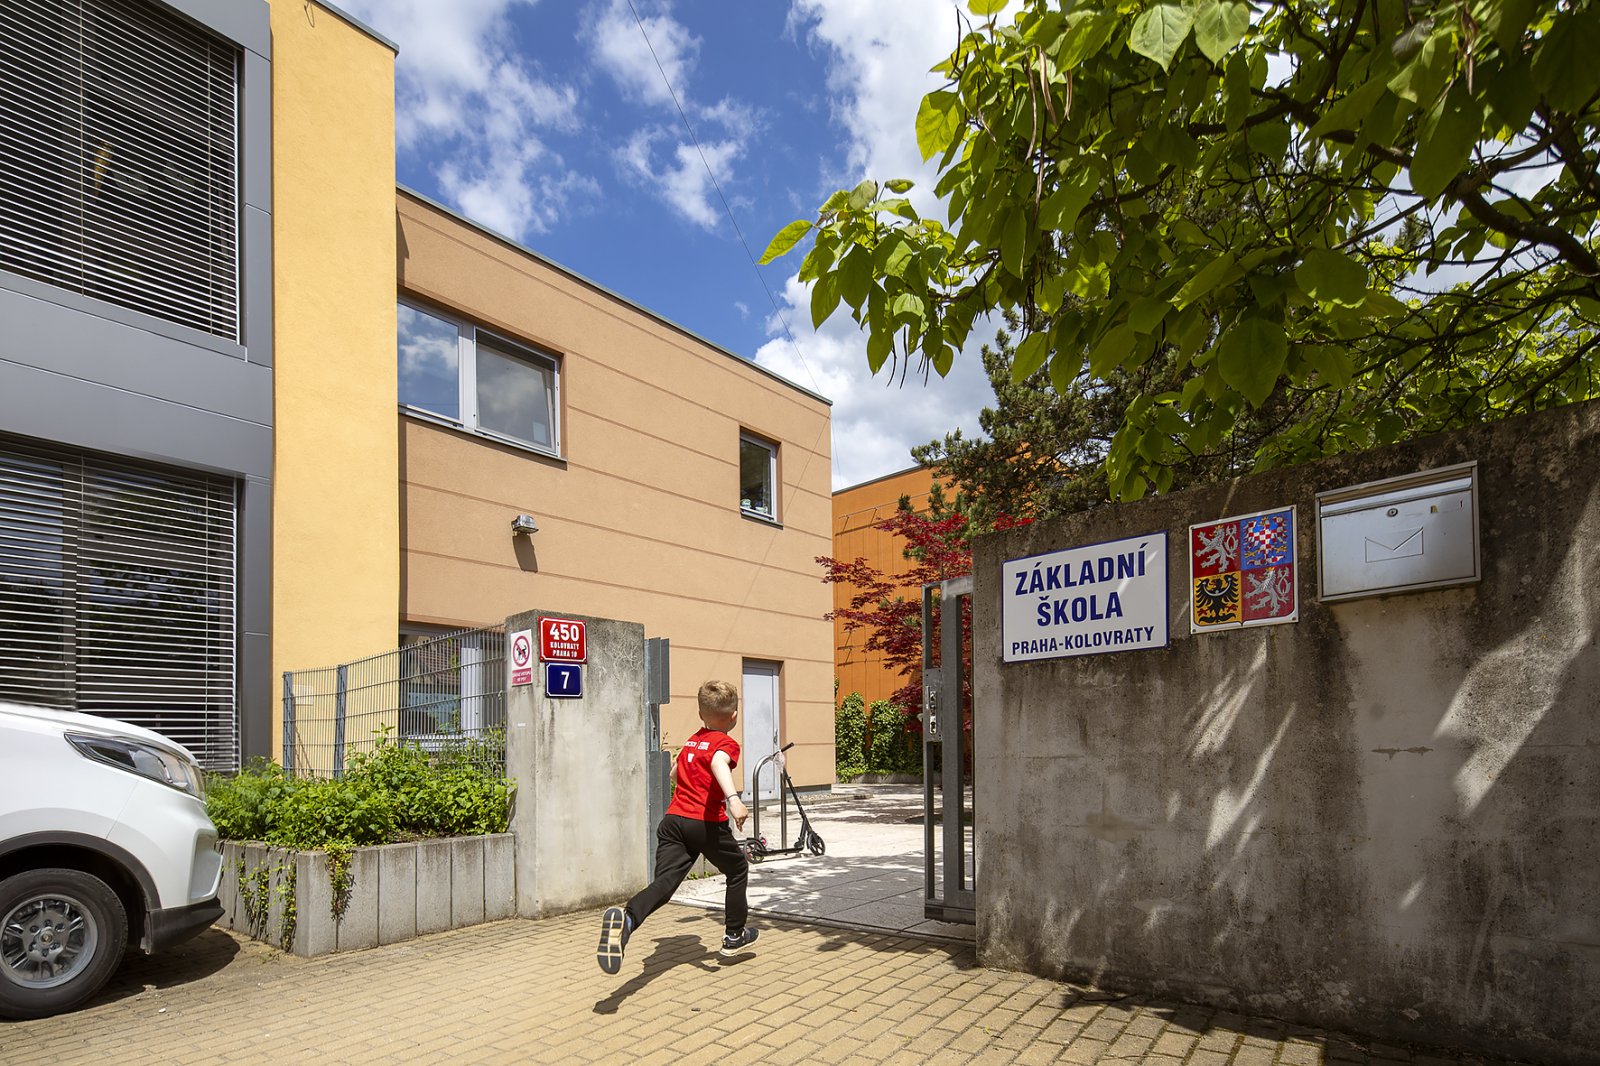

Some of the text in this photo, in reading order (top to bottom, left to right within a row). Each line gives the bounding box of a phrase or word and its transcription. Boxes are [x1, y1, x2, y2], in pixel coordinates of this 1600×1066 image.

[1015, 542, 1149, 596] ZÁKLADNÍ
[1036, 591, 1124, 627] ŠKOLA
[549, 623, 580, 642] 450
[1012, 626, 1155, 655] PRAHA-KOLOVRATY
[561, 671, 570, 690] 7
